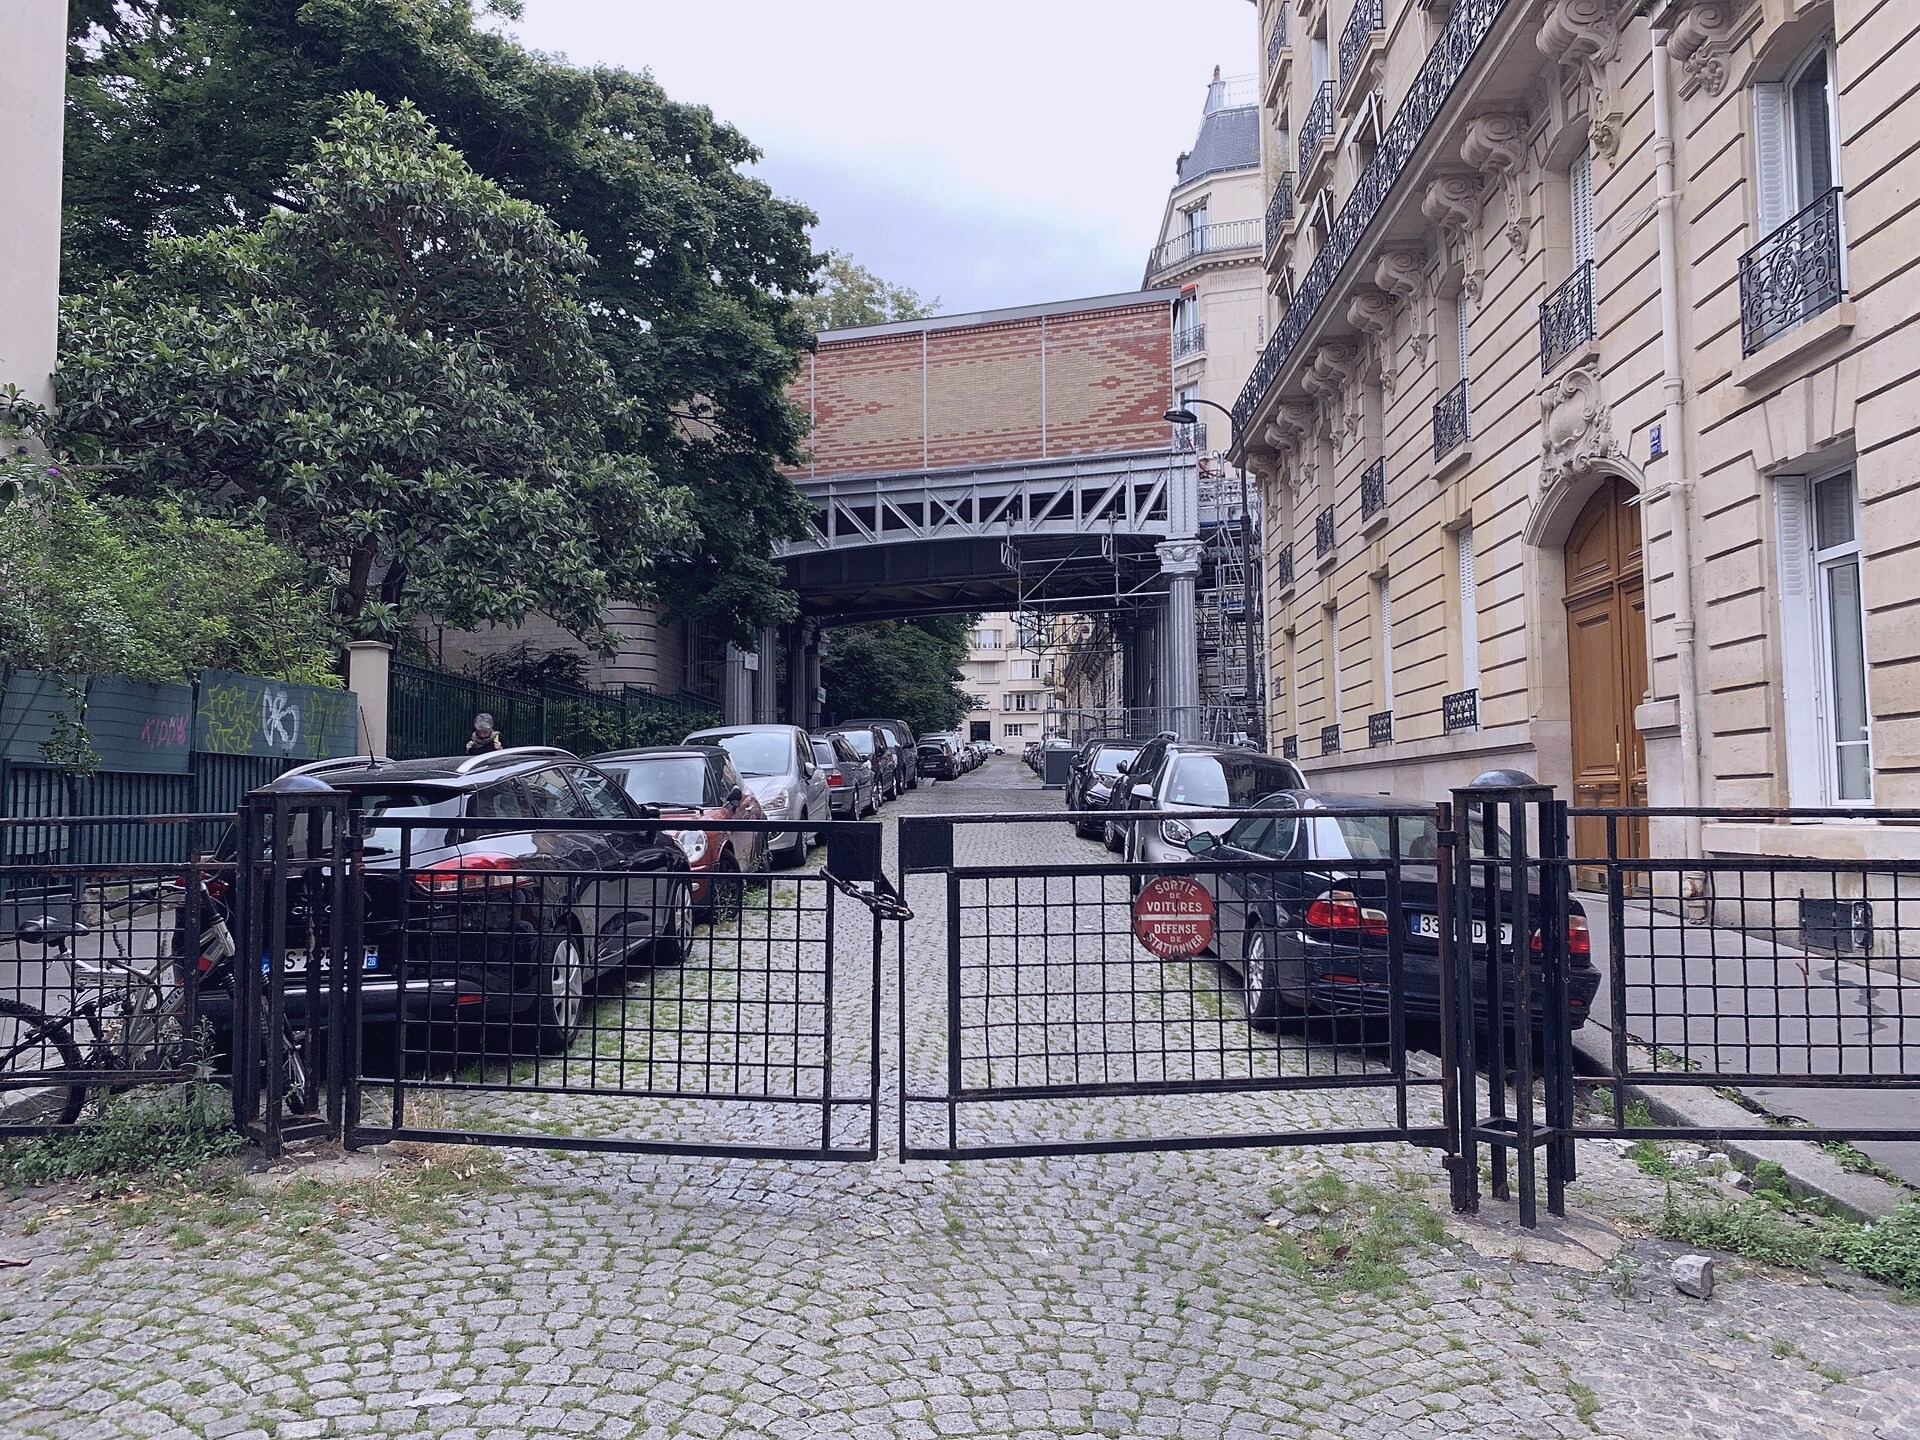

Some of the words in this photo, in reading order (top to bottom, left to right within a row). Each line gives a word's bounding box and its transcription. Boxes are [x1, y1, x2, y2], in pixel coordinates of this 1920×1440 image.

[1155, 880, 1198, 897] SORTIE
[1146, 901, 1202, 912] VOITURES
[1154, 922, 1198, 934] DÉFENSE
[1149, 932, 1205, 955] STATIONNER
